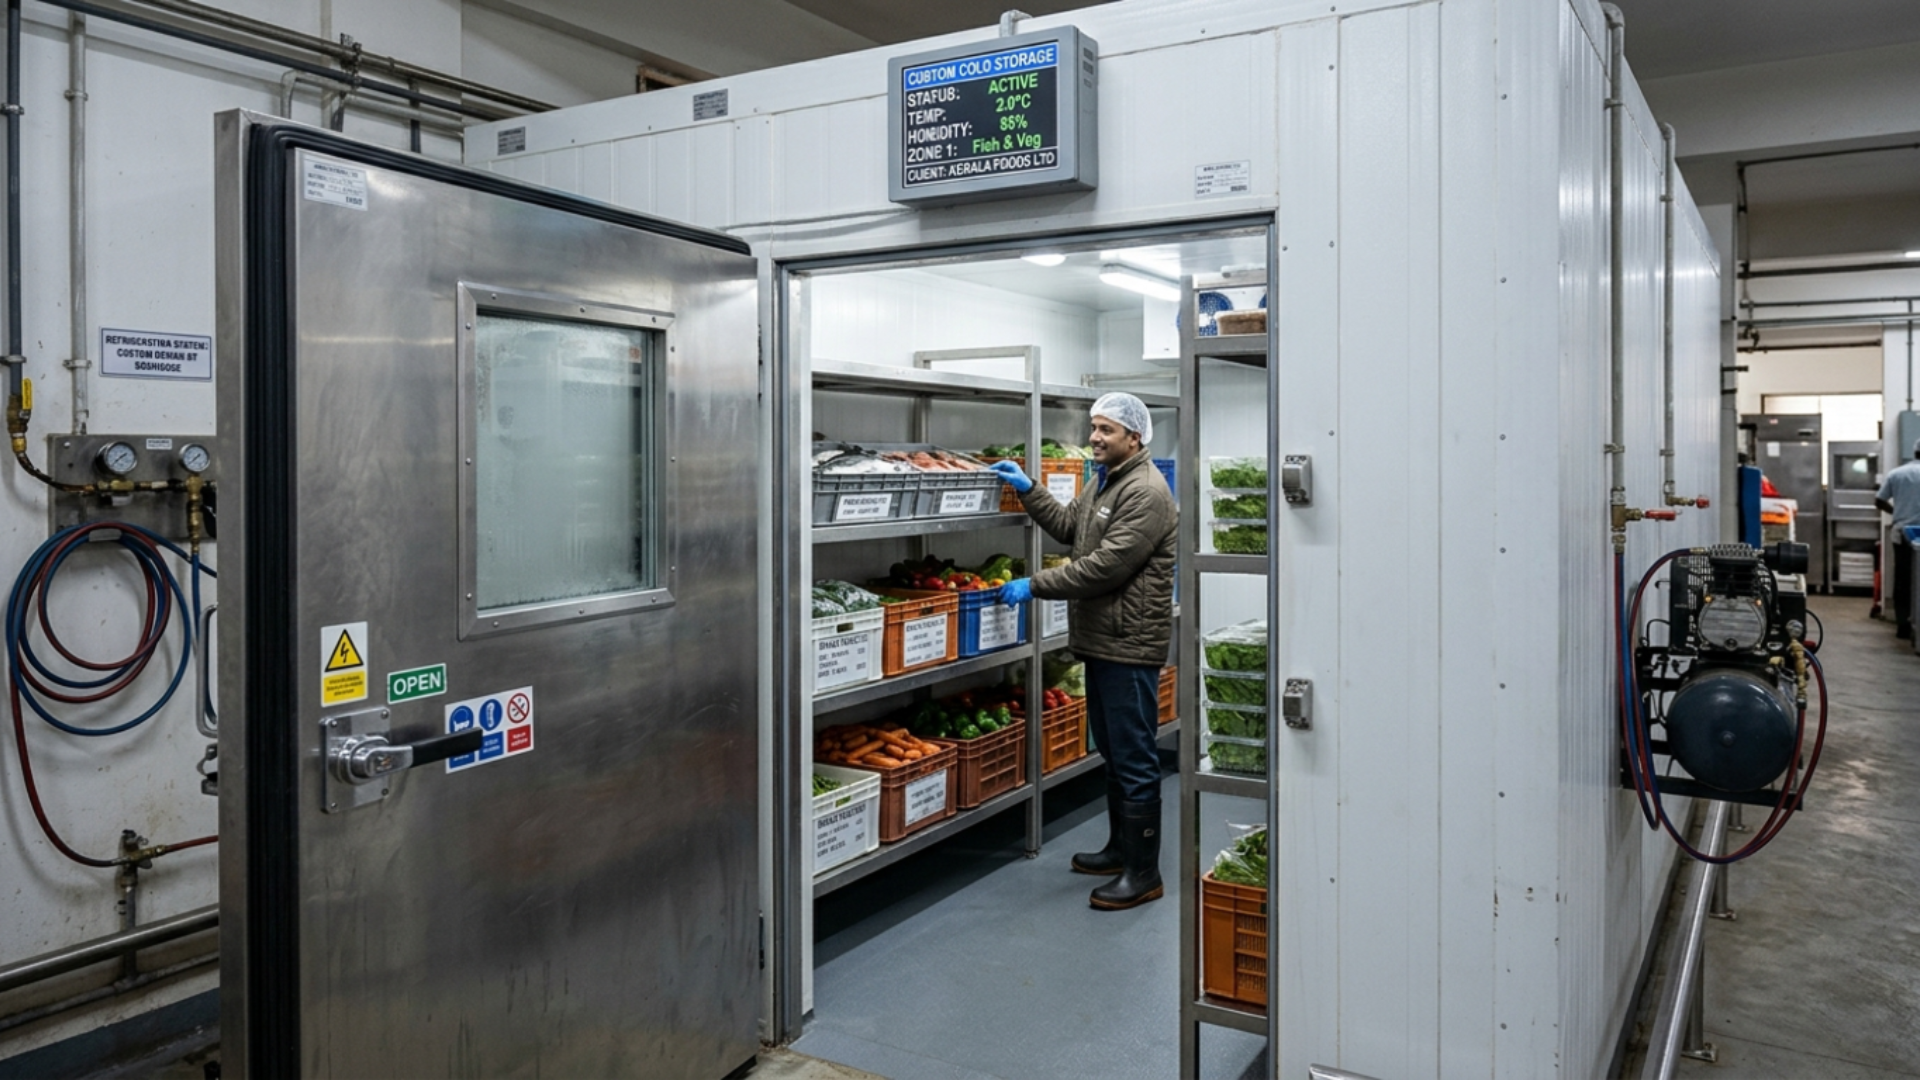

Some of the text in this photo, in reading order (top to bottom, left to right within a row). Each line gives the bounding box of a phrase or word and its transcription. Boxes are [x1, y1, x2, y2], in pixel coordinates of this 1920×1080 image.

[994, 48, 1054, 71] STORAGE
[988, 73, 1038, 94] ACTIVE
[946, 144, 958, 157] 1:
[1003, 134, 1013, 150] &
[1016, 132, 1042, 149] Veg
[393, 671, 442, 696] OPEN
